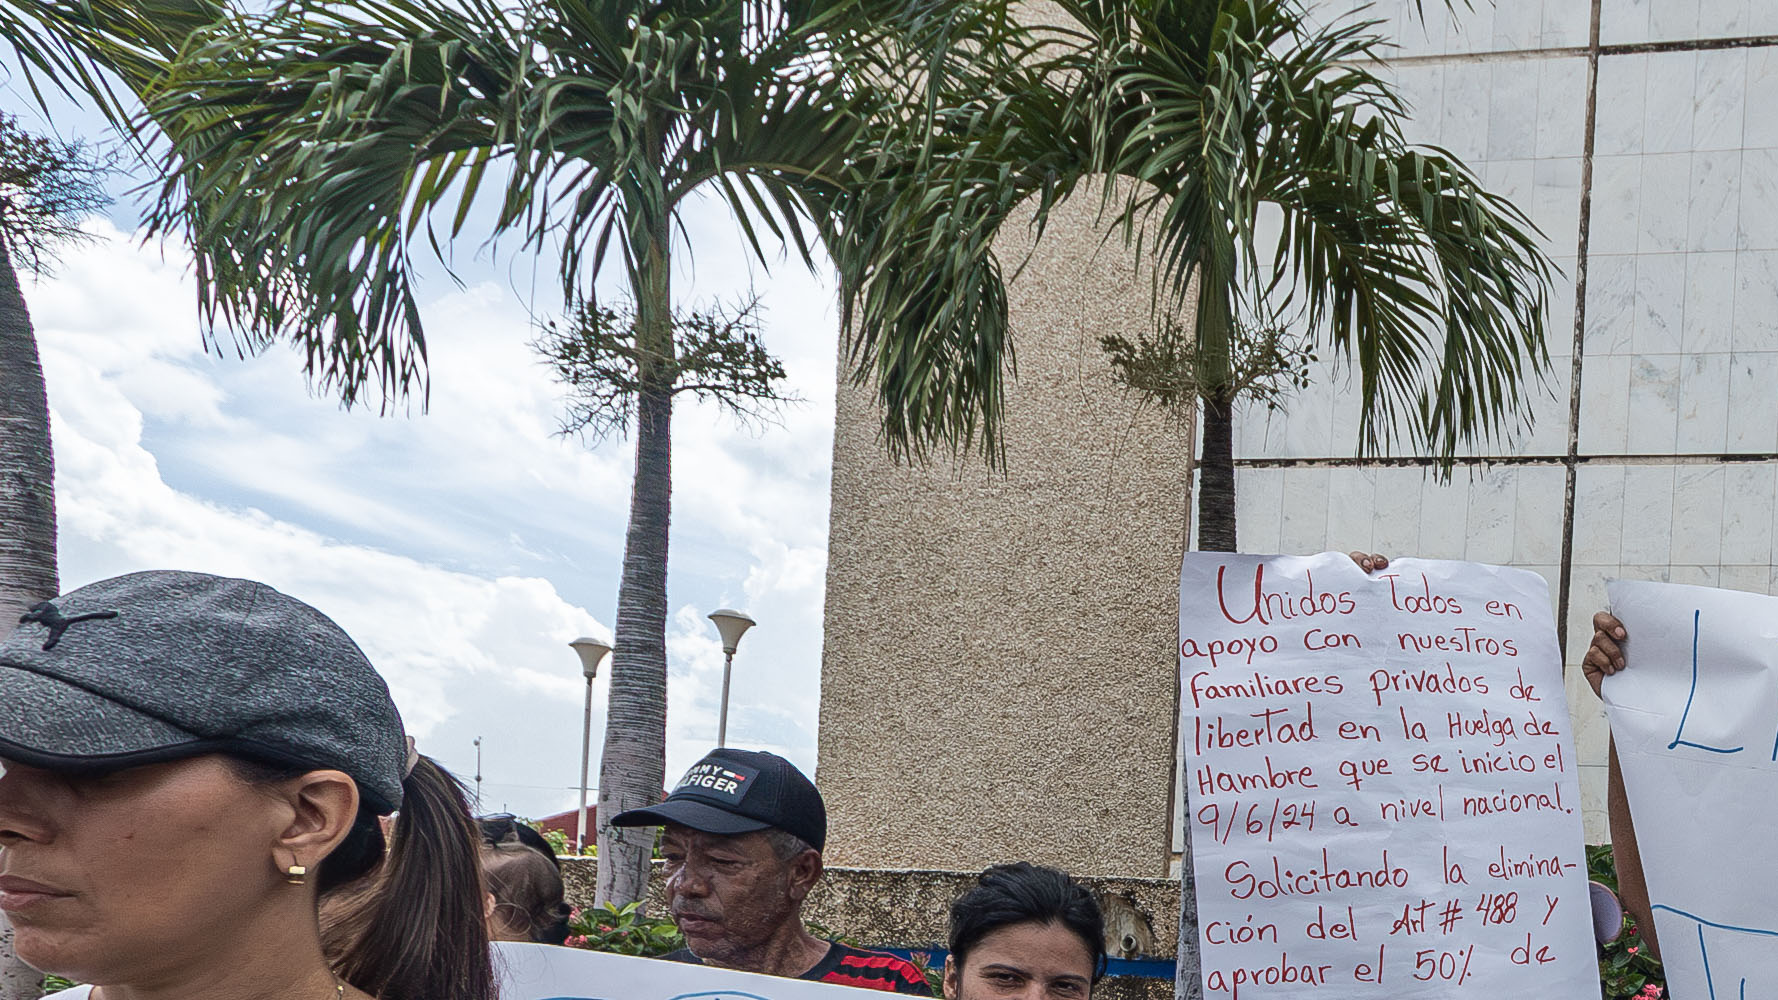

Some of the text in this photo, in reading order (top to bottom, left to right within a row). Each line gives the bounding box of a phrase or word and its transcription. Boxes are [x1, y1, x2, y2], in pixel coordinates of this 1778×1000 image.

[1216, 562, 1526, 626] Unidos Todos en
[1180, 630, 1279, 668] apoyo
[1190, 661, 1541, 708] familiares privados de
[1338, 719, 1382, 742] en
[1399, 706, 1428, 740] la
[1447, 711, 1516, 747] Huelga
[1522, 712, 1560, 736] de
[1196, 743, 1564, 796] Hambre que se inicio el
[1197, 781, 1574, 844] 9/6/24 a nivel nacional.
[1223, 845, 1577, 900] Solicitando la elimina-
[1205, 913, 1279, 945] ción
[1305, 905, 1358, 940] del
[1438, 898, 1464, 935] #
[1475, 891, 1519, 927] 488
[1353, 943, 1385, 983] el
[1412, 943, 1475, 986] 50%
[1509, 932, 1557, 965] de
